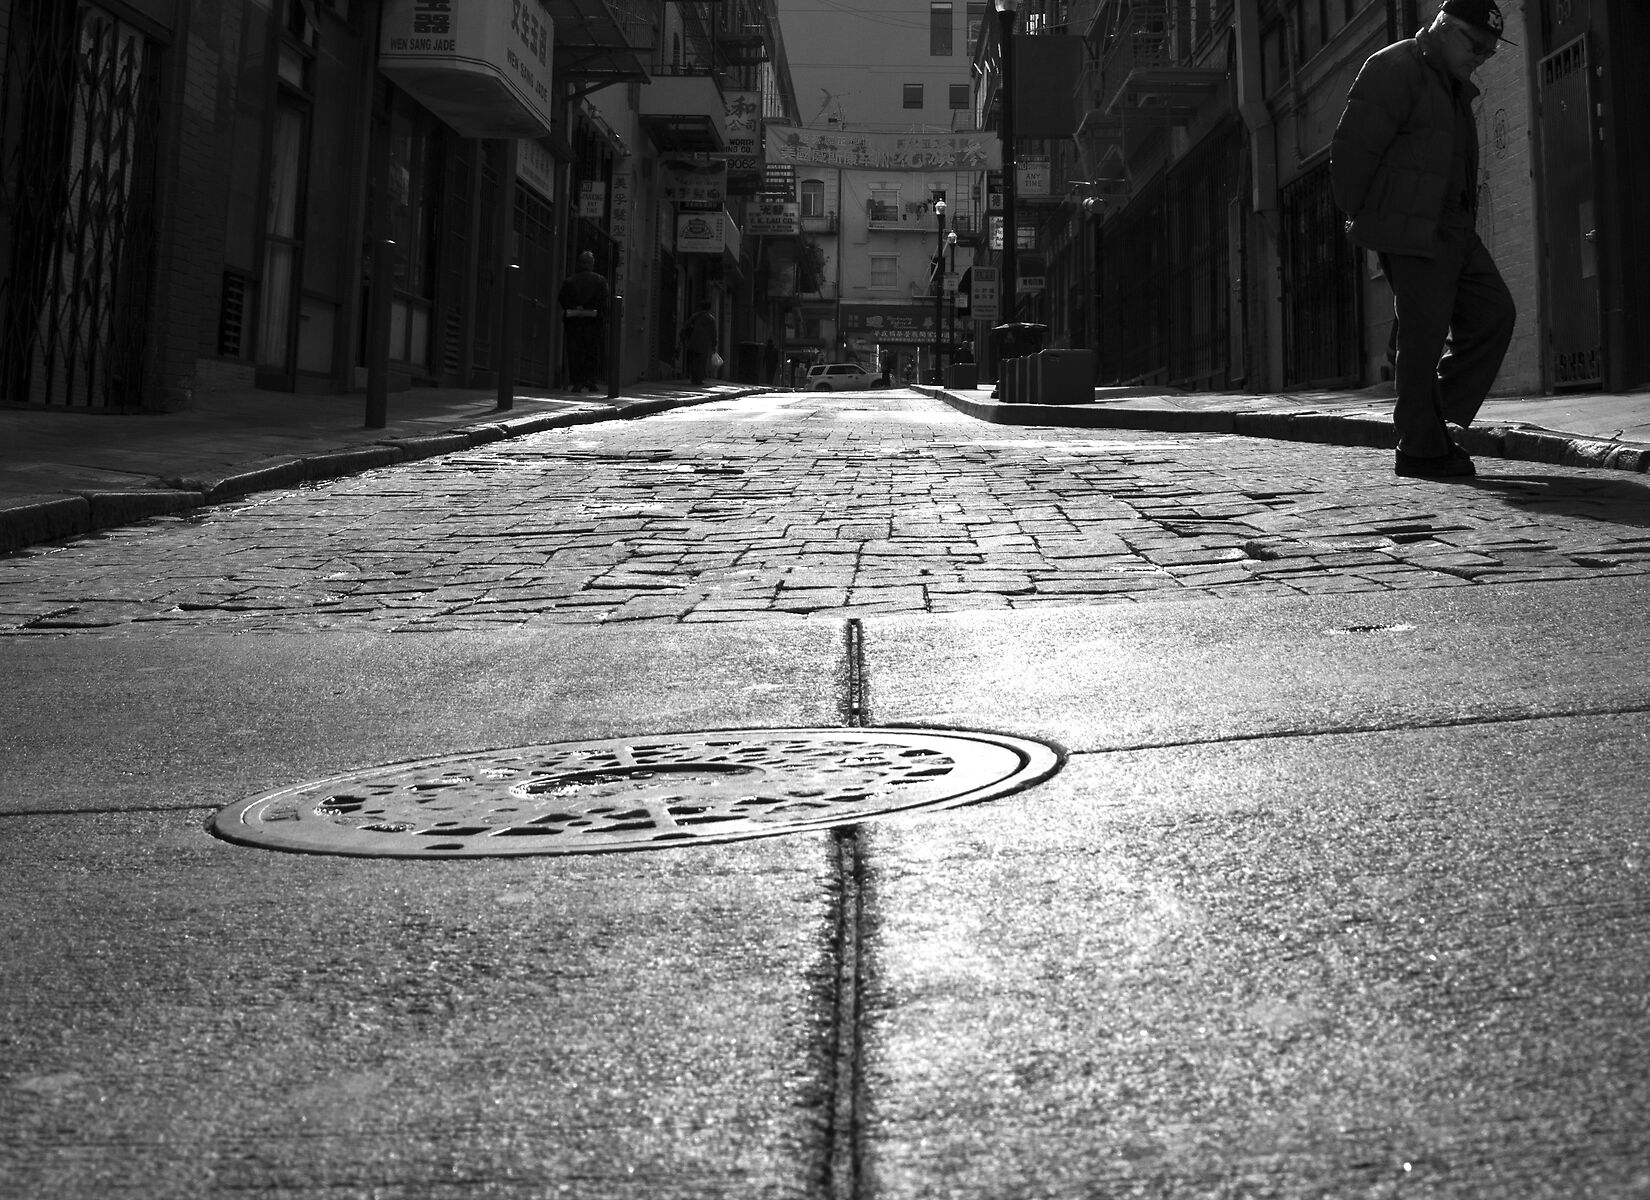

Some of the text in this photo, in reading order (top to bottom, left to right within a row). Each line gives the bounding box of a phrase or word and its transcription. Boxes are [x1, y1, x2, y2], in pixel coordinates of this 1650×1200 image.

[390, 38, 455, 51] WEN SANG JADE
[506, 47, 548, 103] WEN SANG JADE
[729, 138, 754, 146] WORTH
[727, 158, 756, 169] 9062
